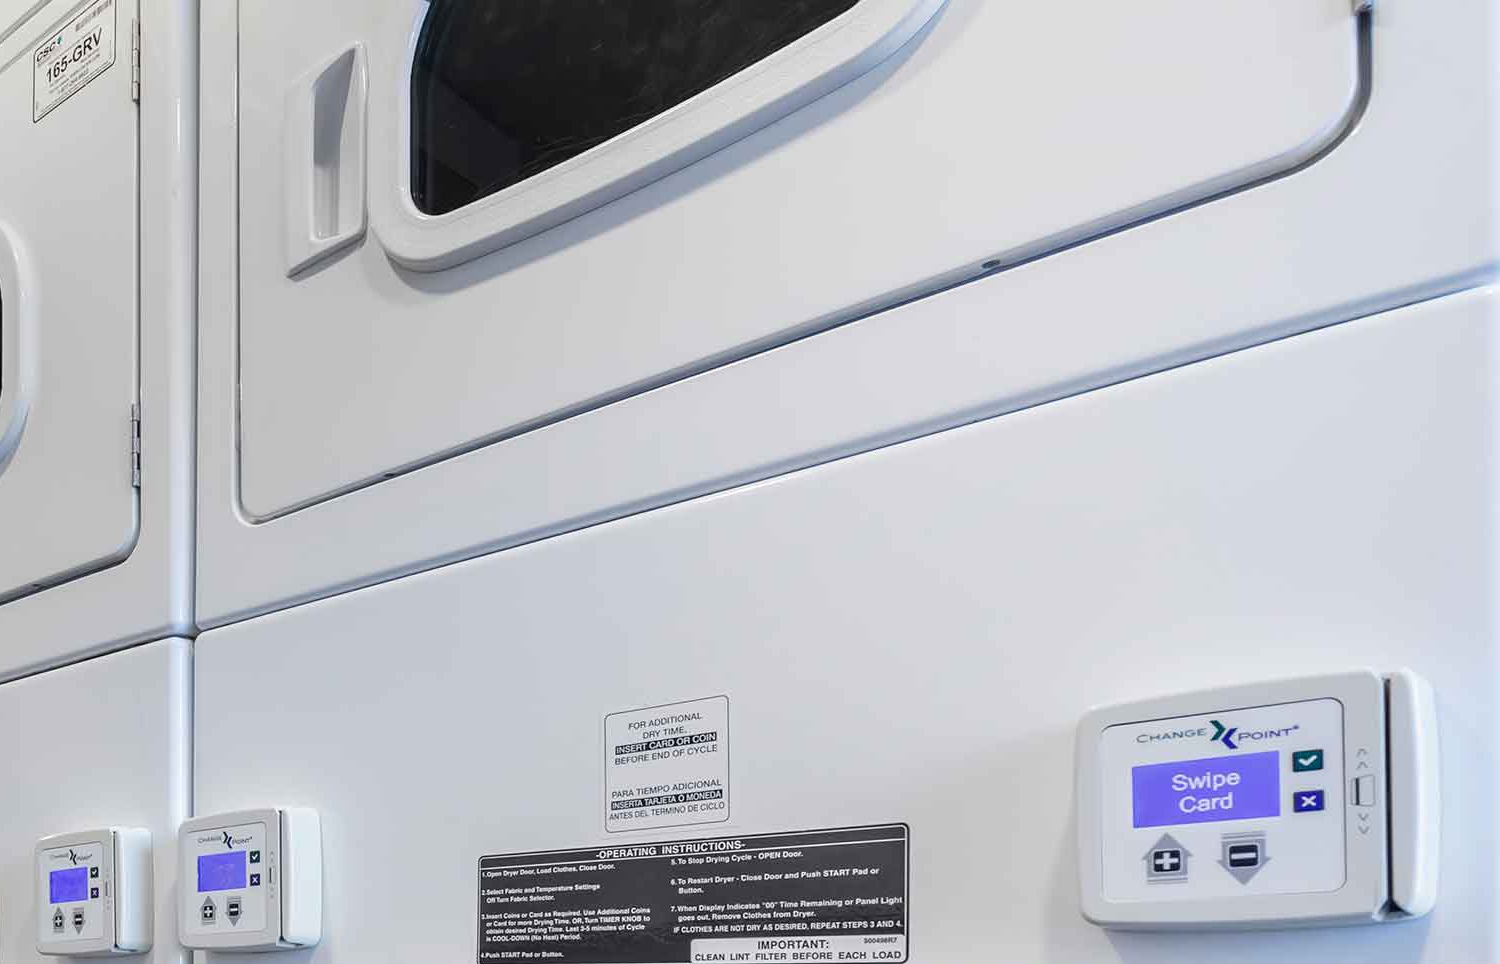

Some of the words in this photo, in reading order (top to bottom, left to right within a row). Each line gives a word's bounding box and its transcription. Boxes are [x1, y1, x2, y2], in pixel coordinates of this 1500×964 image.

[46, 27, 102, 82] 165-GRV
[628, 722, 646, 730] FOR
[649, 713, 702, 726] ADDITIONAL
[616, 743, 647, 754] INSERT
[649, 739, 674, 749] CARD
[677, 736, 690, 746] OR
[692, 733, 716, 742] COIN
[643, 730, 660, 739] DRY
[615, 754, 649, 765] BEFORE
[652, 751, 670, 760] END
[672, 749, 685, 757] OF
[687, 744, 717, 755] CYCLE
[612, 789, 634, 798] PARA
[636, 785, 670, 795] TIEMPO
[672, 779, 722, 791] ADICIONAL
[1172, 771, 1242, 792] Swipe
[612, 799, 643, 809] INSERTA
[645, 796, 676, 806] TARJETA
[678, 794, 685, 802] O
[686, 791, 721, 801] MONEDA
[1179, 791, 1234, 813] Card
[609, 811, 633, 820] ANTES
[652, 806, 685, 816] TERMINO
[688, 804, 698, 812] DE
[700, 802, 724, 811] CICLO
[823, 869, 850, 877] START
[763, 923, 773, 931] AS
[757, 940, 829, 950] IMPORTANT:
[792, 952, 833, 960] BEFORE
[839, 951, 867, 959] EACH
[873, 951, 901, 959] LOAD
